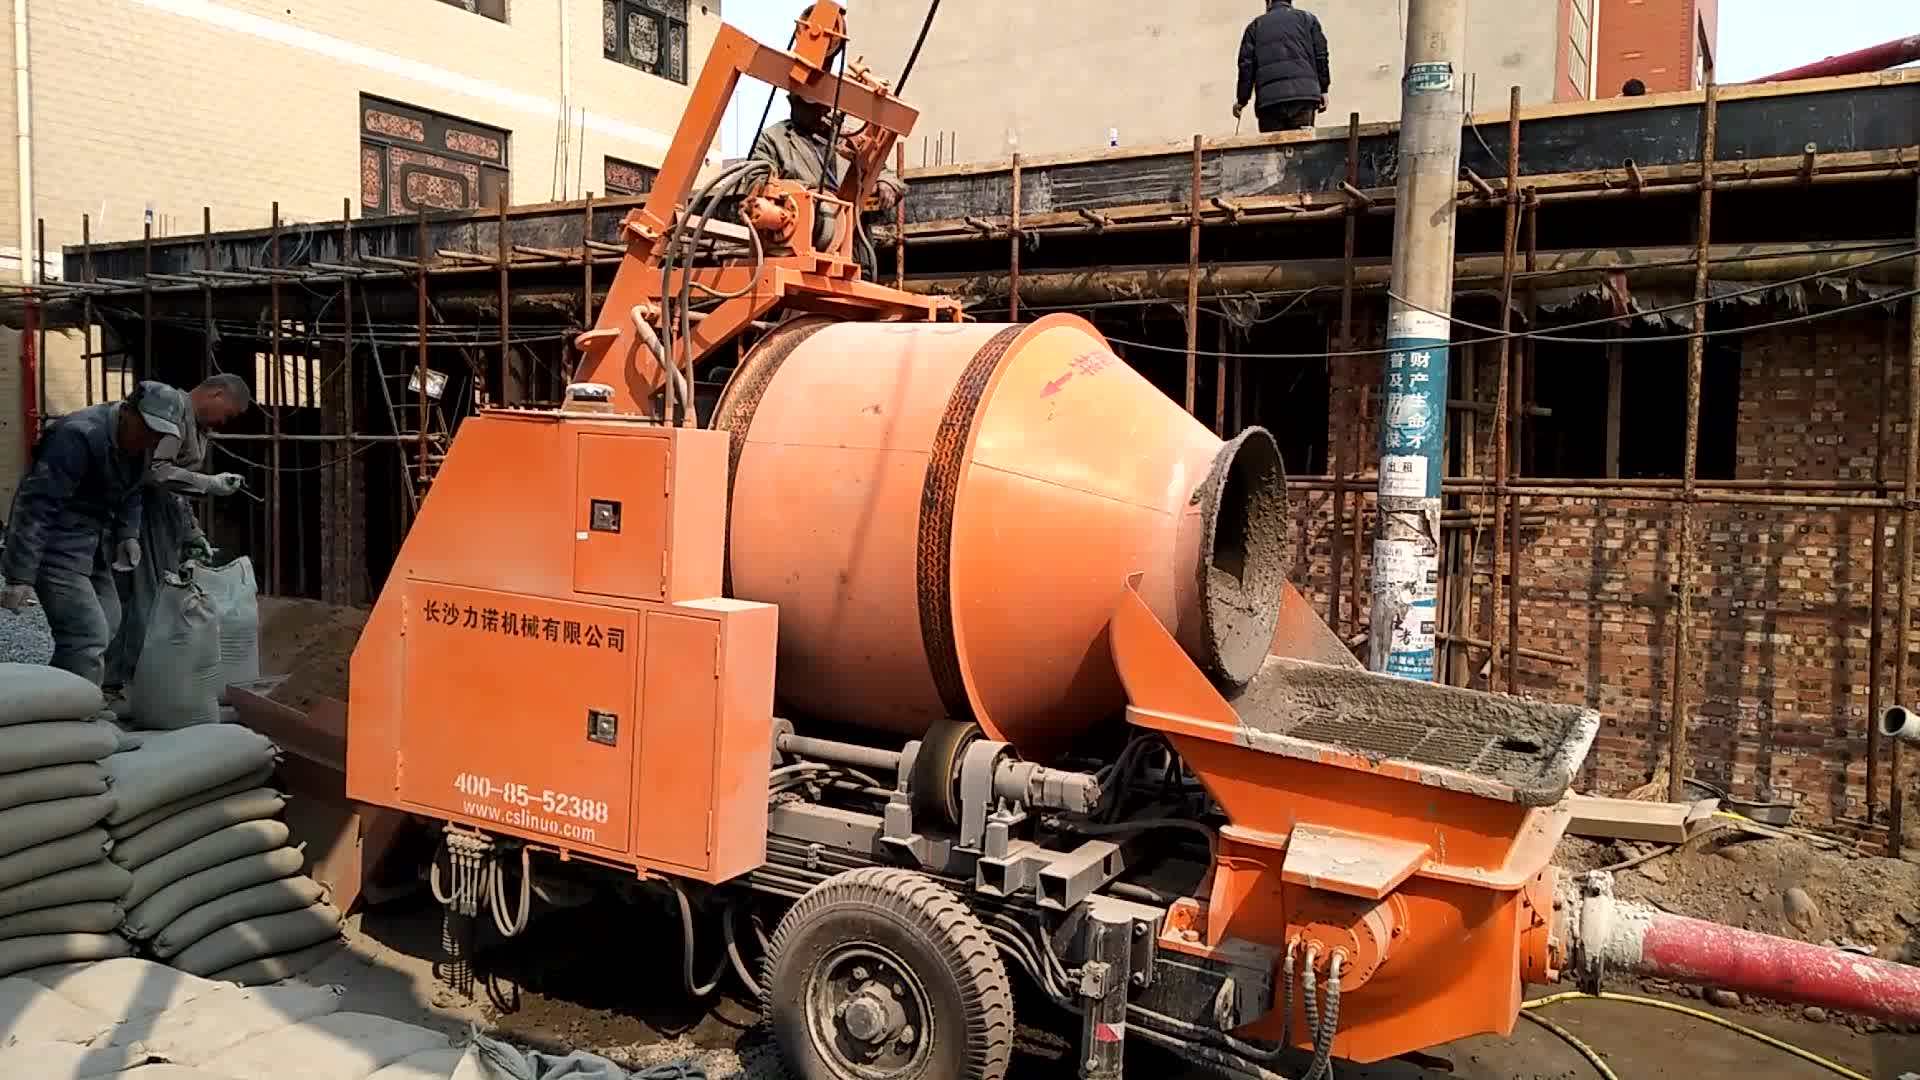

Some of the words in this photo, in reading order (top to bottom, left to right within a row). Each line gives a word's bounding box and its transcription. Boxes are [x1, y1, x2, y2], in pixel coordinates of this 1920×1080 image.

[1385, 352, 1406, 455] 普及用电保
[1406, 351, 1431, 455] 财产生命才
[423, 599, 625, 652] 长沙力诺机械有限公司
[453, 772, 609, 823] 400-85-52388
[463, 800, 596, 842] www.cslinuo.com
